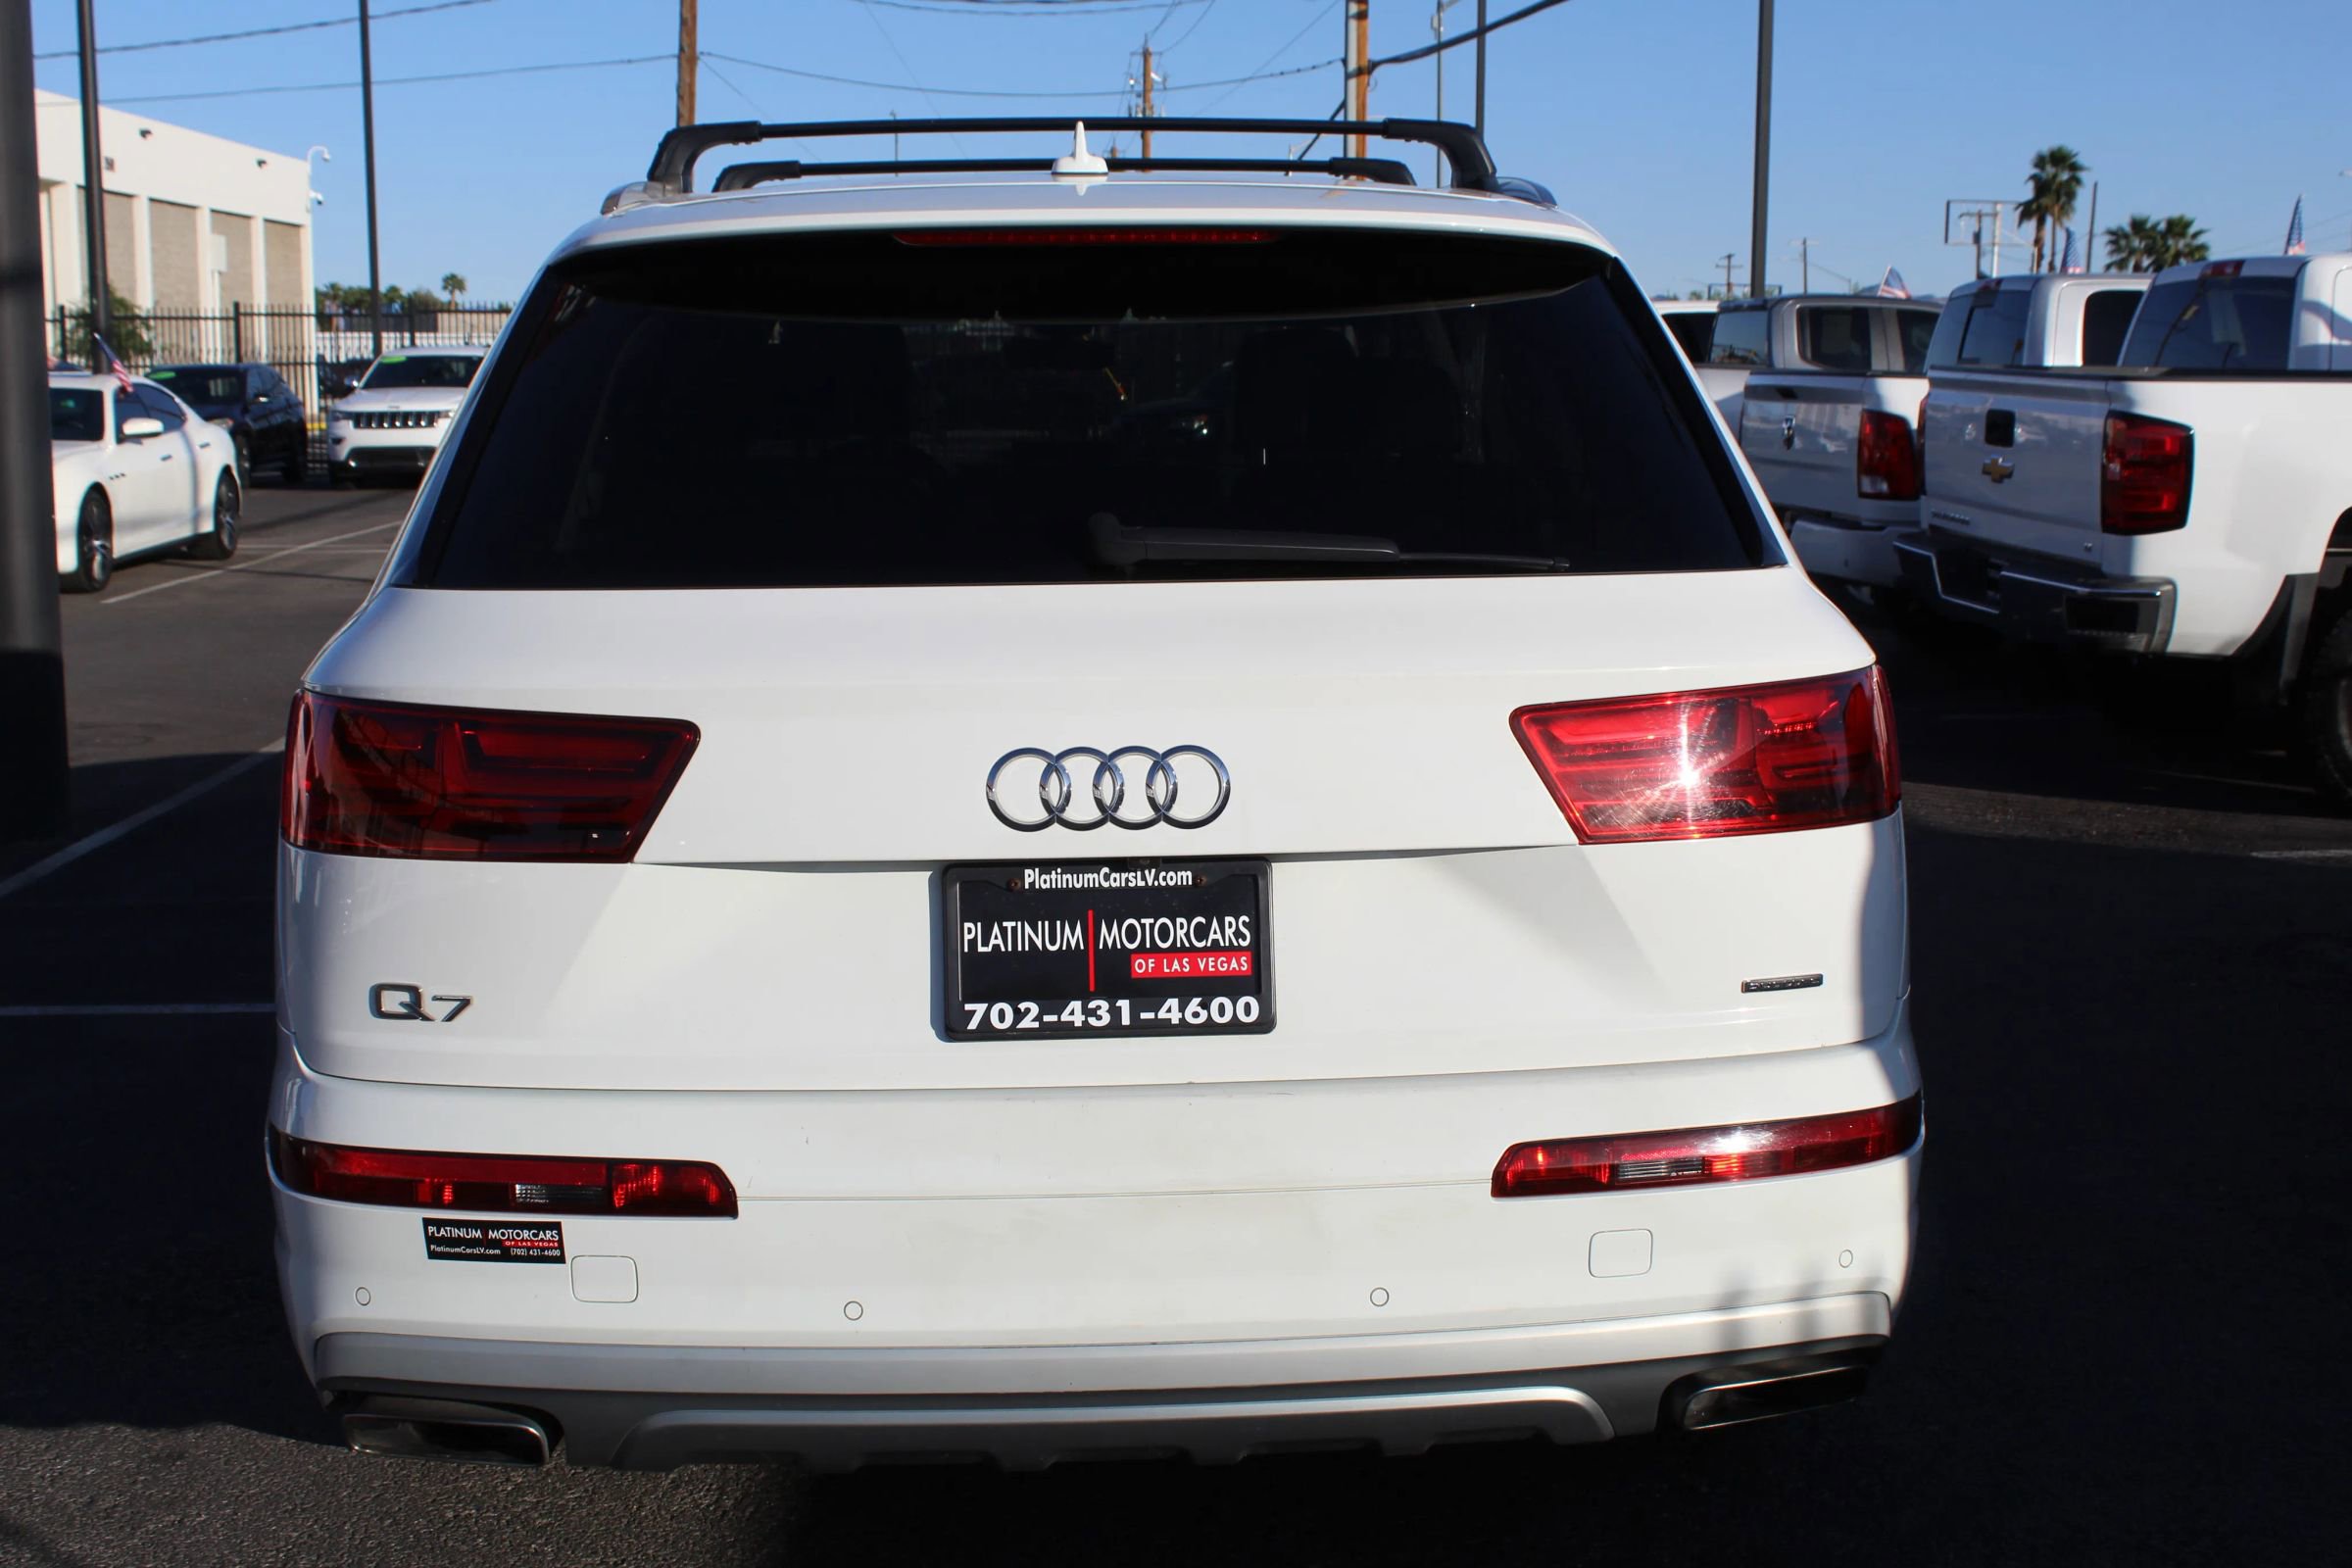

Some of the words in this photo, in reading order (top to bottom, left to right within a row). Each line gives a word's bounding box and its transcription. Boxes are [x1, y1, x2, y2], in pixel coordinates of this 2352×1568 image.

[1024, 867, 1193, 890] PlatinumCarsLV.com
[963, 919, 1084, 953] PLATINUM
[1099, 915, 1250, 951] MOTORCARS
[1134, 958, 1156, 973] OF
[1163, 957, 1190, 973] LAS
[1197, 956, 1249, 972] VEGAS
[368, 983, 472, 1022] Q7
[963, 996, 1260, 1030] 702-431-4600
[427, 1226, 482, 1239] PLATINUM
[488, 1229, 559, 1241] MOTORCARS
[430, 1245, 501, 1254] PlatinumCarsLV.com
